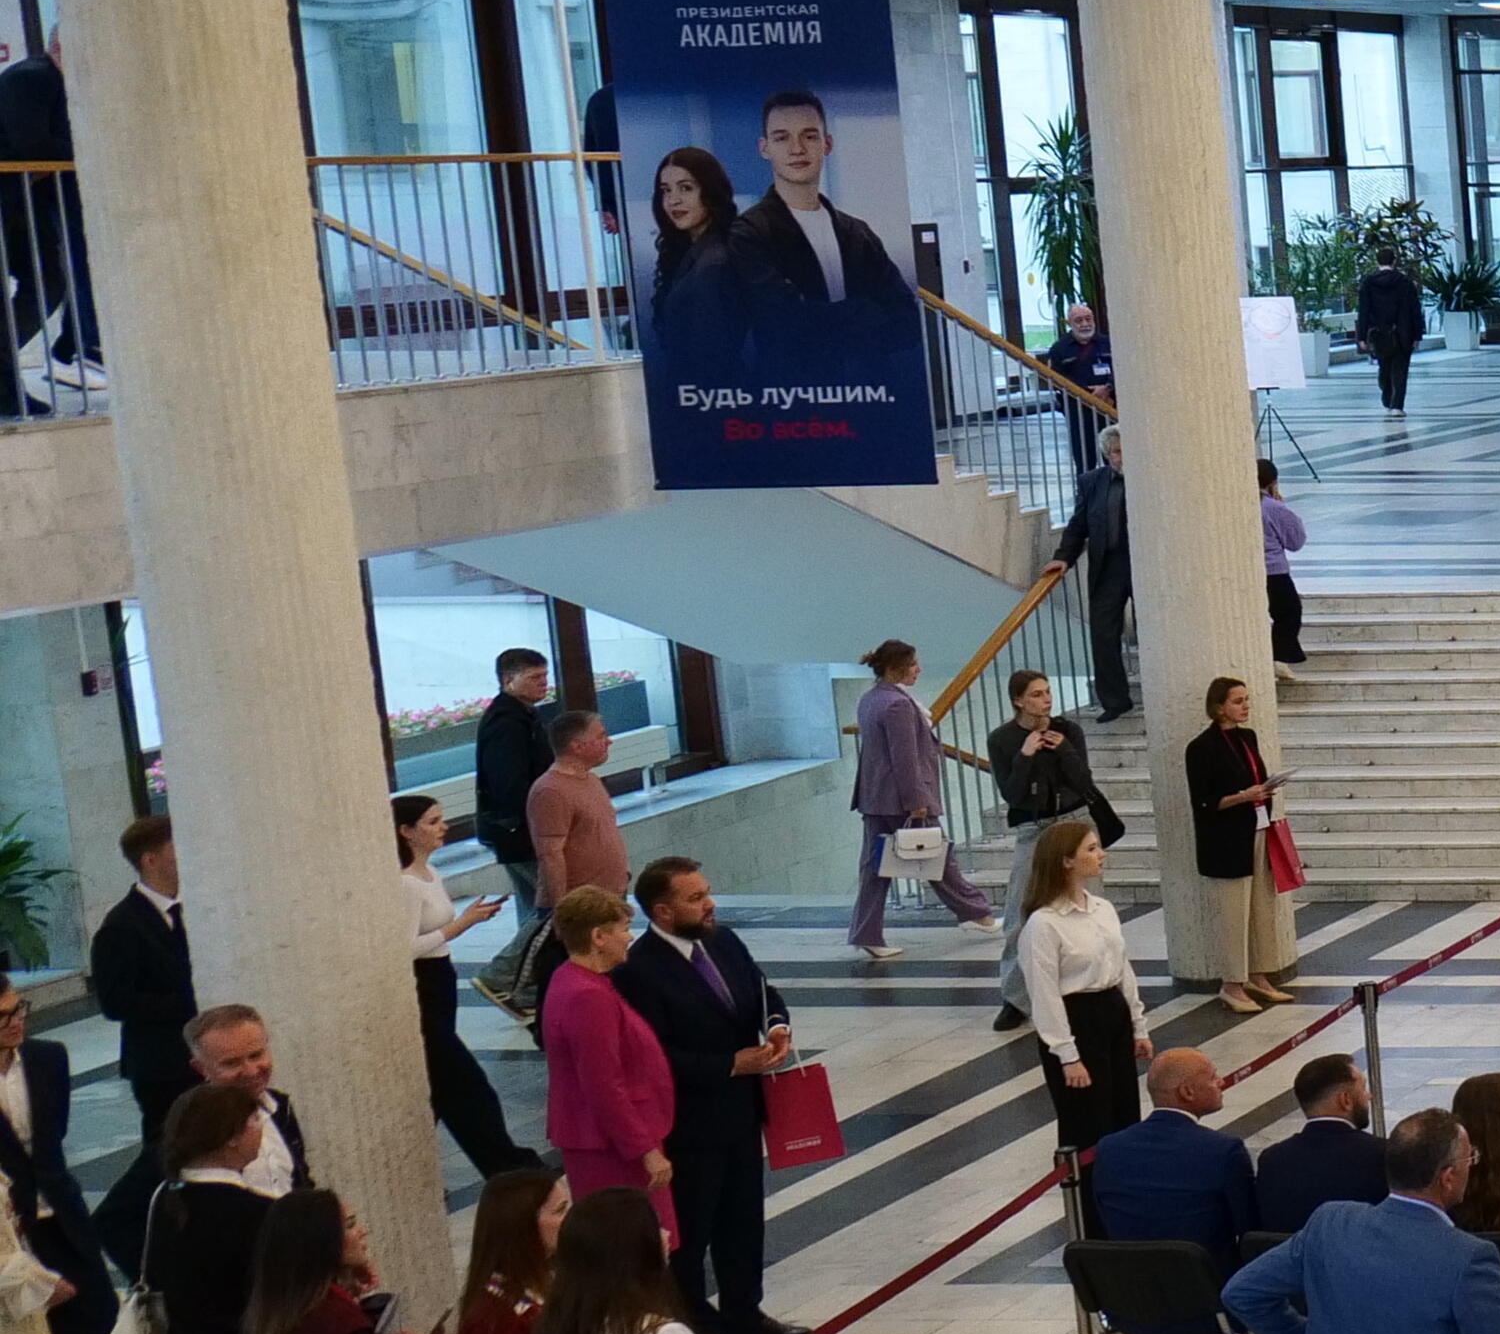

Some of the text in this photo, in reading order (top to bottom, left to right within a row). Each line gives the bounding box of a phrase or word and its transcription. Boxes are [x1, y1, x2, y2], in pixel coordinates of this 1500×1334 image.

[676, 4, 820, 19] ПРЕЗИДЕНТСКАЯ
[680, 21, 823, 48] АКАДЕМИЯ
[678, 381, 896, 411] Будь лучшим.
[724, 417, 857, 441] Во всём.
